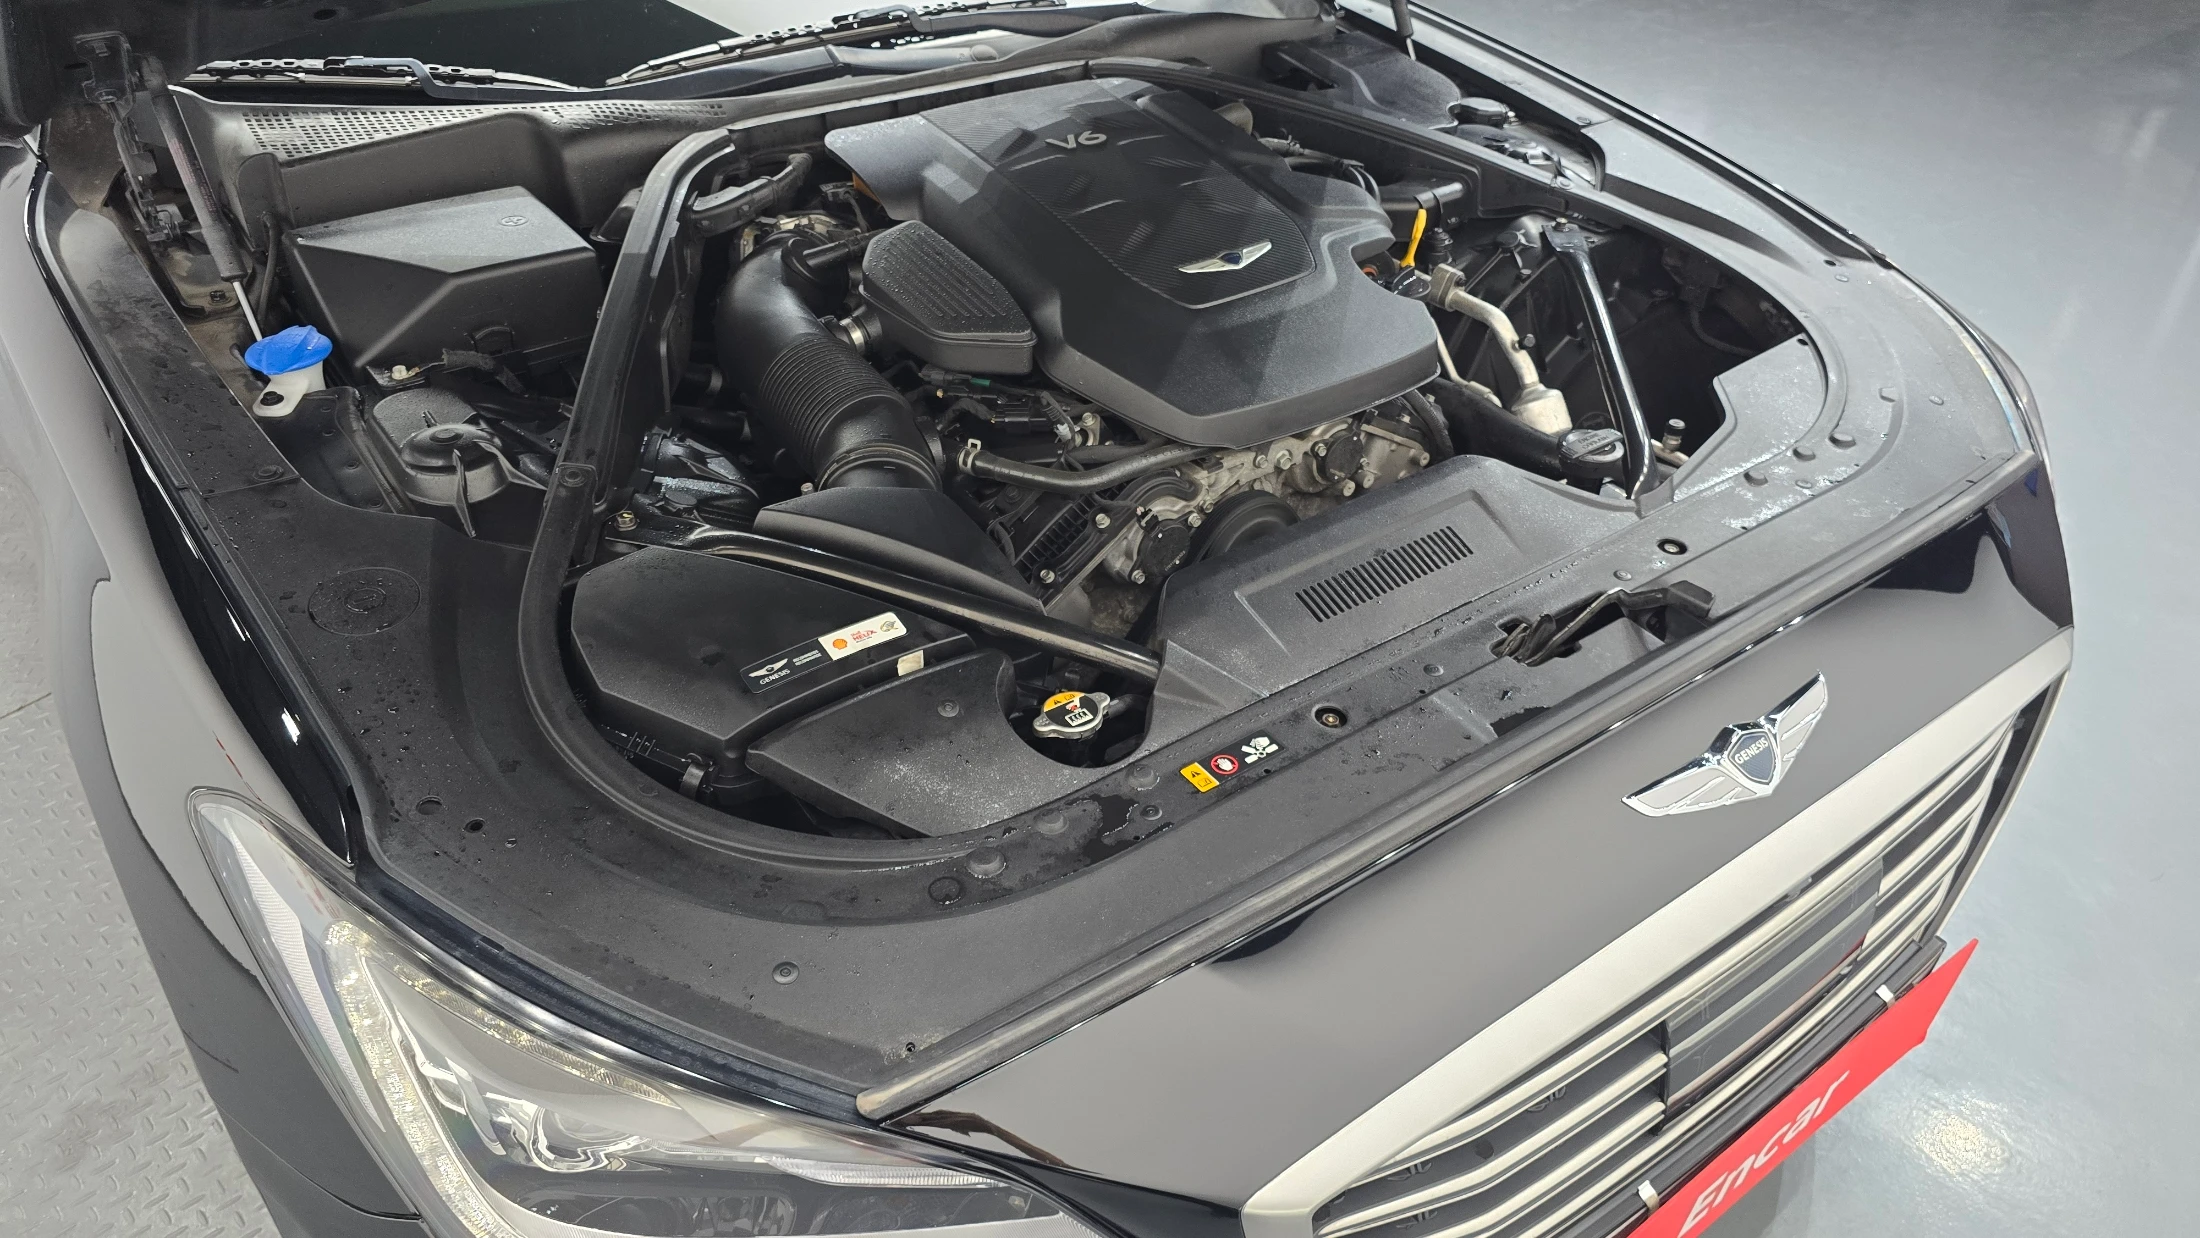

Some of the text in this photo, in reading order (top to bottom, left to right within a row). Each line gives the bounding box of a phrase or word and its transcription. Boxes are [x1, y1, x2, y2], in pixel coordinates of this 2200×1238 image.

[1045, 130, 1108, 150] V6
[760, 668, 791, 685] GENESIS
[1734, 736, 1770, 765] GENESIS
[1677, 1069, 1851, 1238] Encar
